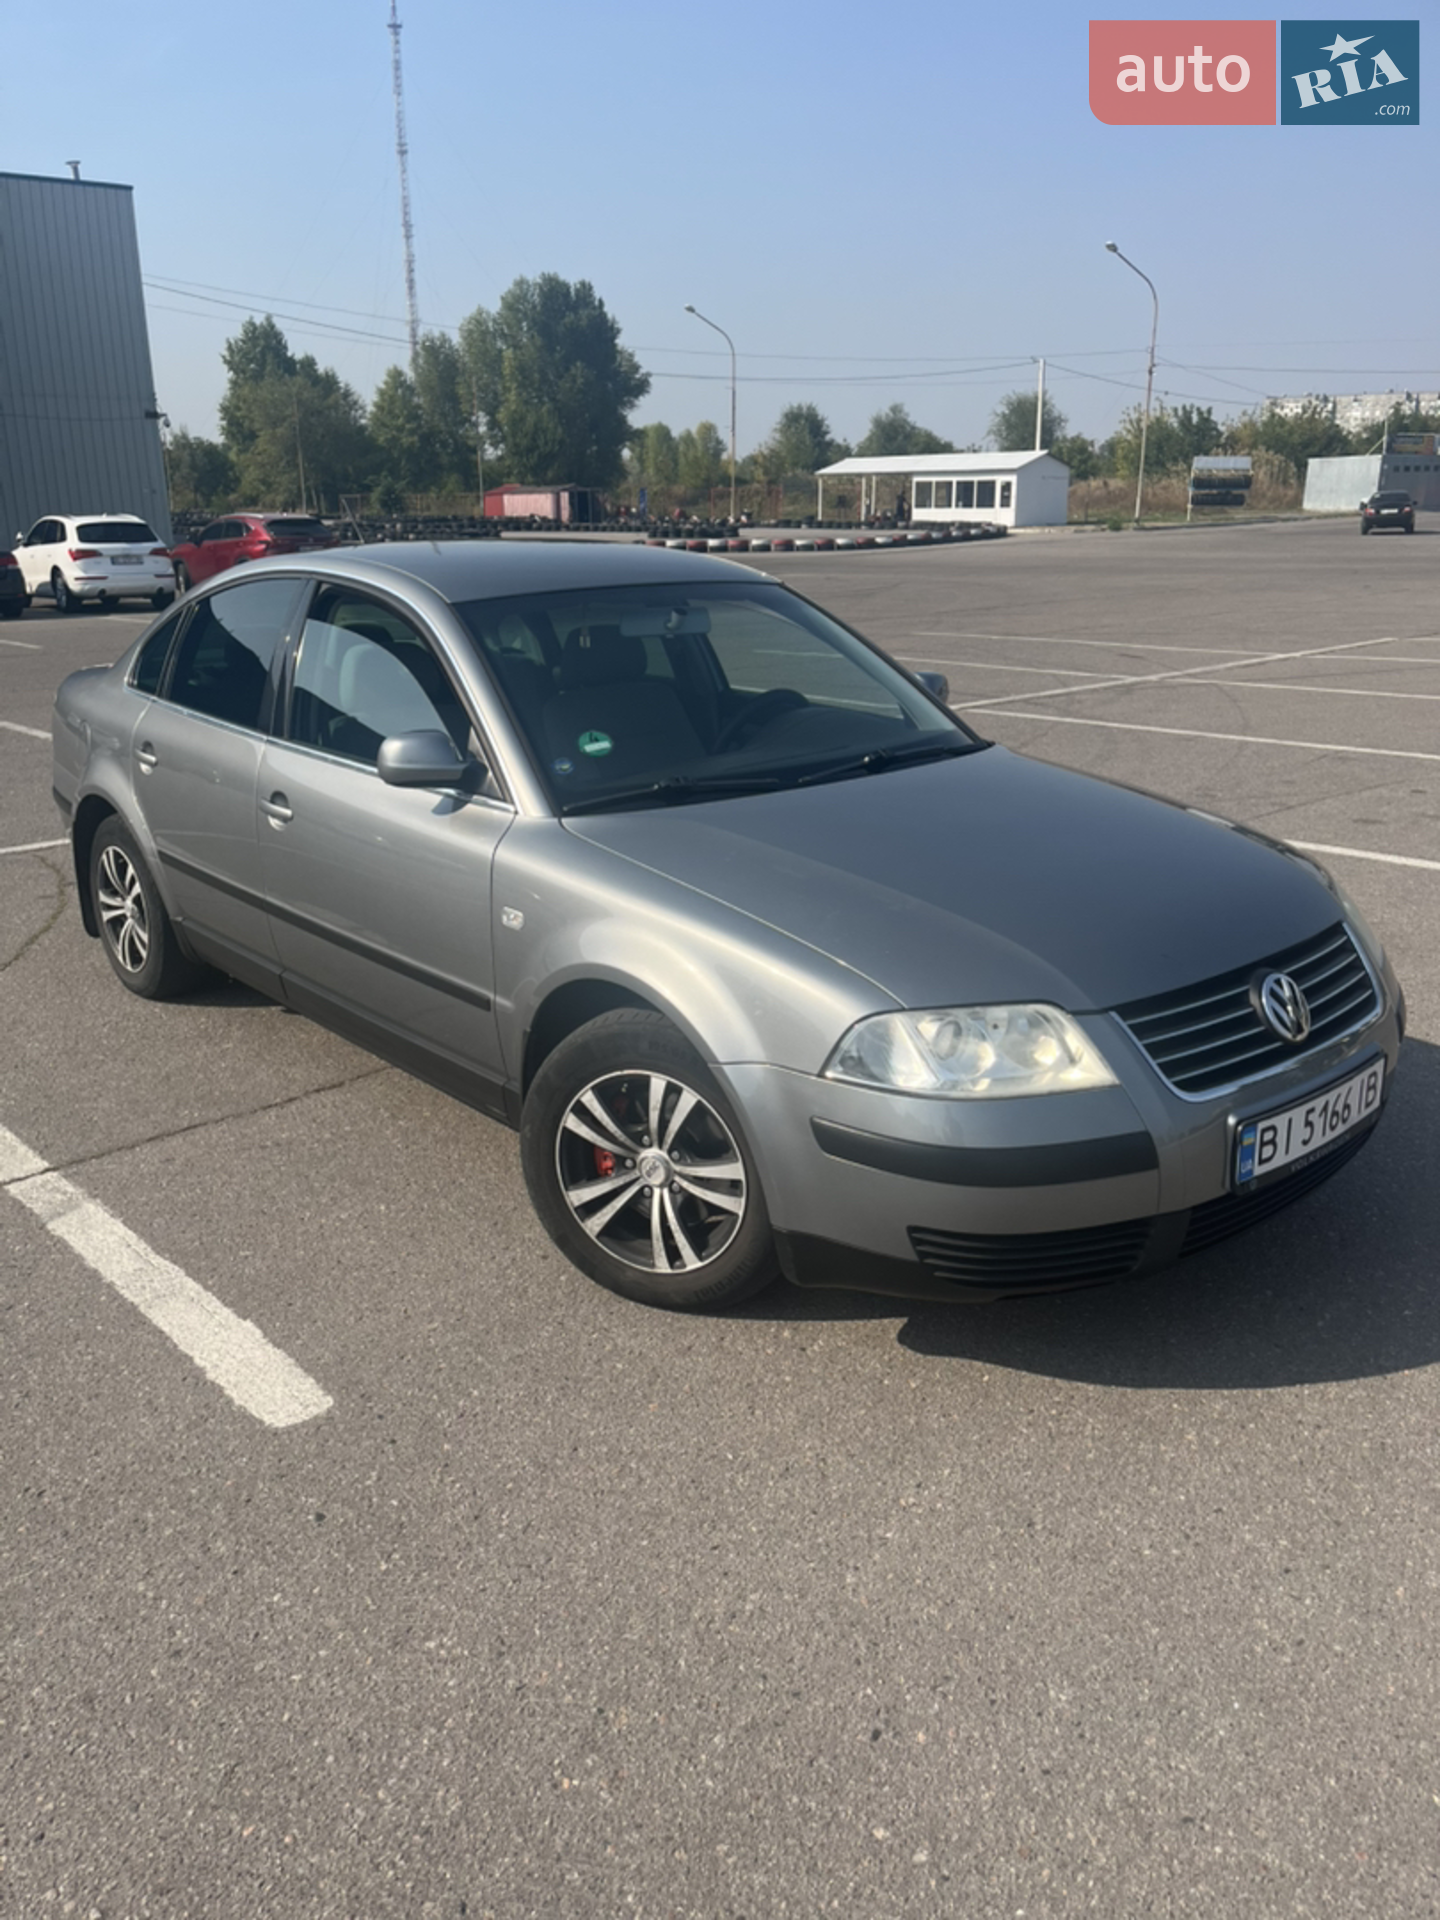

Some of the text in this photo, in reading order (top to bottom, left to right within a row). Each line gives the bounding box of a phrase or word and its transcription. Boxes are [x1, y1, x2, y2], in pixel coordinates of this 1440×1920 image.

[1257, 1117, 1293, 1166] BI
[1301, 1085, 1353, 1146] 5166
[1357, 1070, 1380, 1115] IB
